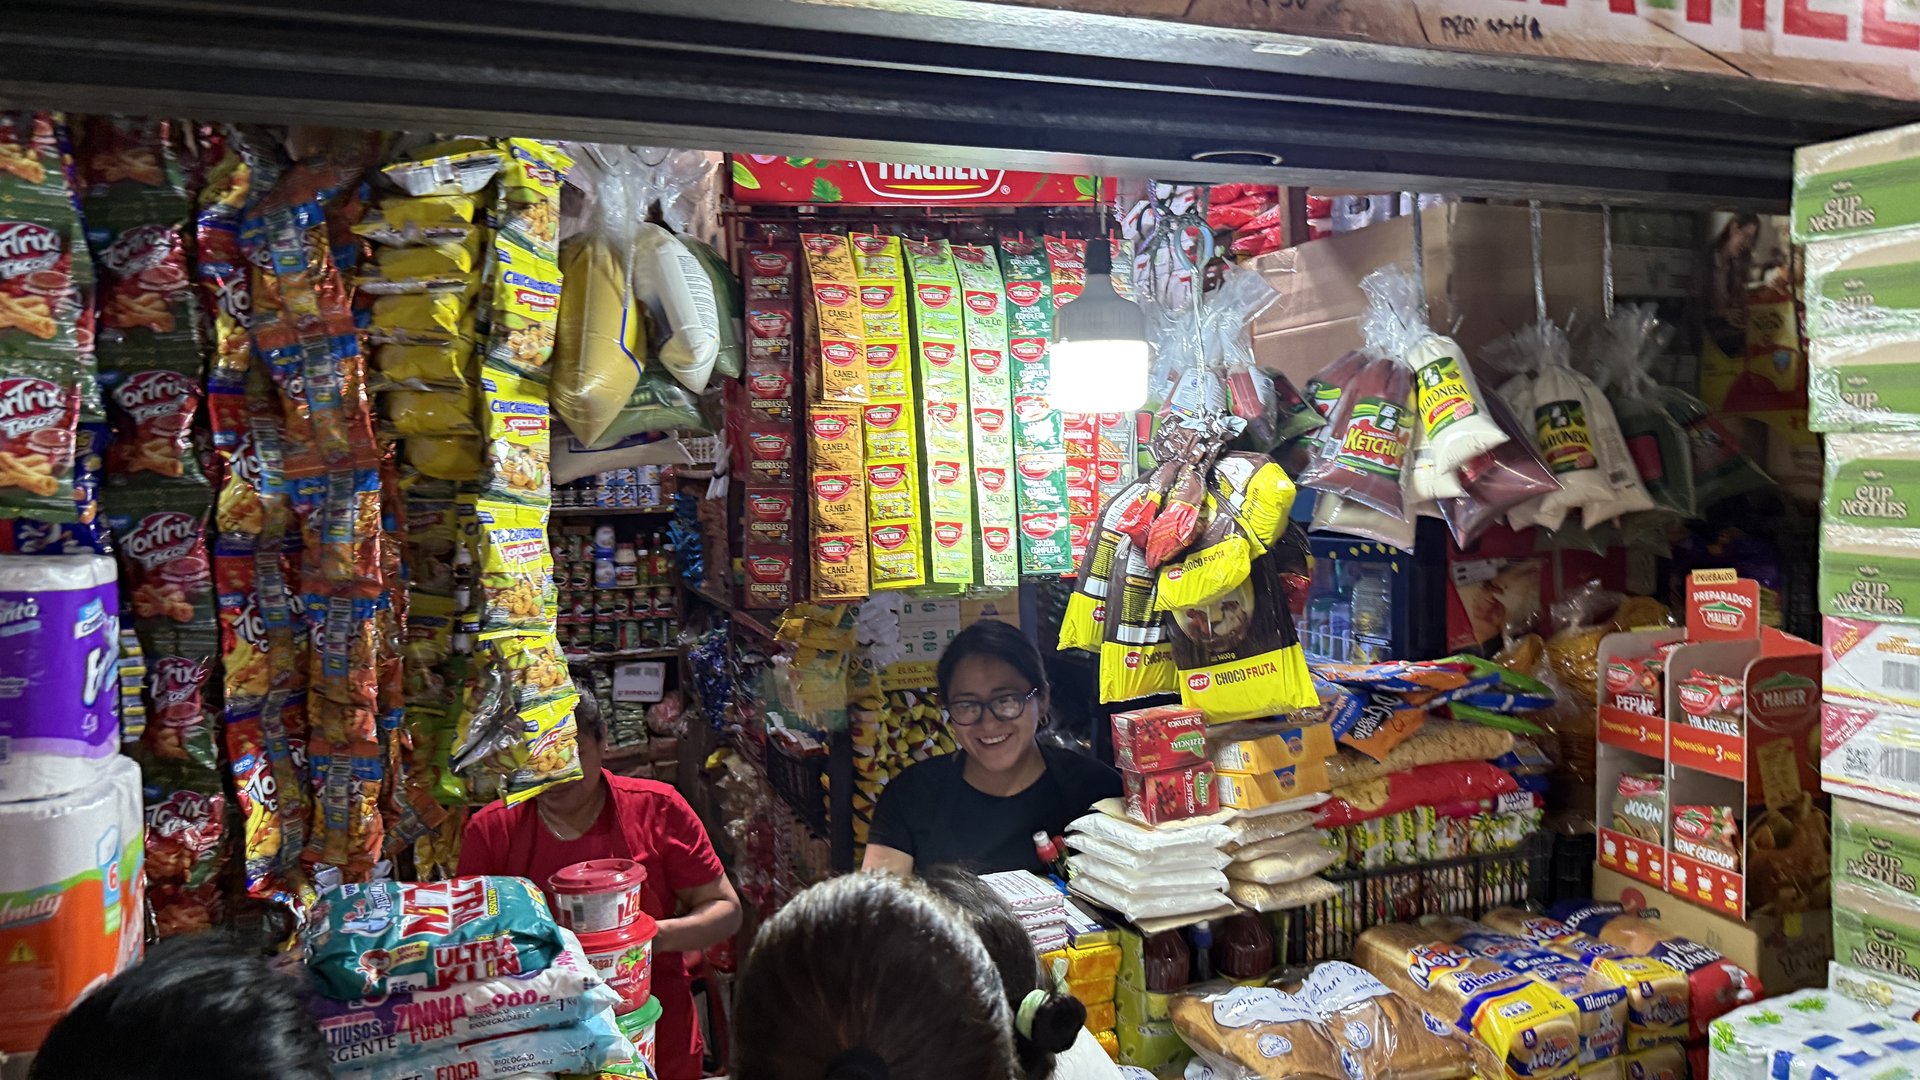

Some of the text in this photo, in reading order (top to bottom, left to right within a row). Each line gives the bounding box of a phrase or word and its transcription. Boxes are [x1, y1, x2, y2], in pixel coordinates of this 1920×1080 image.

[828, 309, 853, 319] CANELA
[833, 369, 858, 379] CANELA
[822, 443, 850, 451] CANELA
[1855, 485, 1893, 502] CUP
[825, 504, 852, 512] CANELA
[827, 566, 855, 574] CANELA
[1851, 580, 1890, 598] CUP
[1693, 590, 1752, 608] PREPARADOS
[1706, 612, 1737, 626] MALHER
[1189, 662, 1278, 687] BEST CHOCO FRUTA
[1640, 725, 1647, 743] 3
[1687, 714, 1740, 736] HILACHAS
[1716, 744, 1723, 763] 3
[1863, 850, 1903, 872] CUP
[434, 936, 518, 969] ULTRA
[1866, 940, 1907, 961] CUP
[1458, 970, 1516, 995] Blanco
[1583, 991, 1620, 1011] Blanco
[392, 994, 467, 1034] ZINNIA
[328, 1034, 397, 1063] RGENTE
